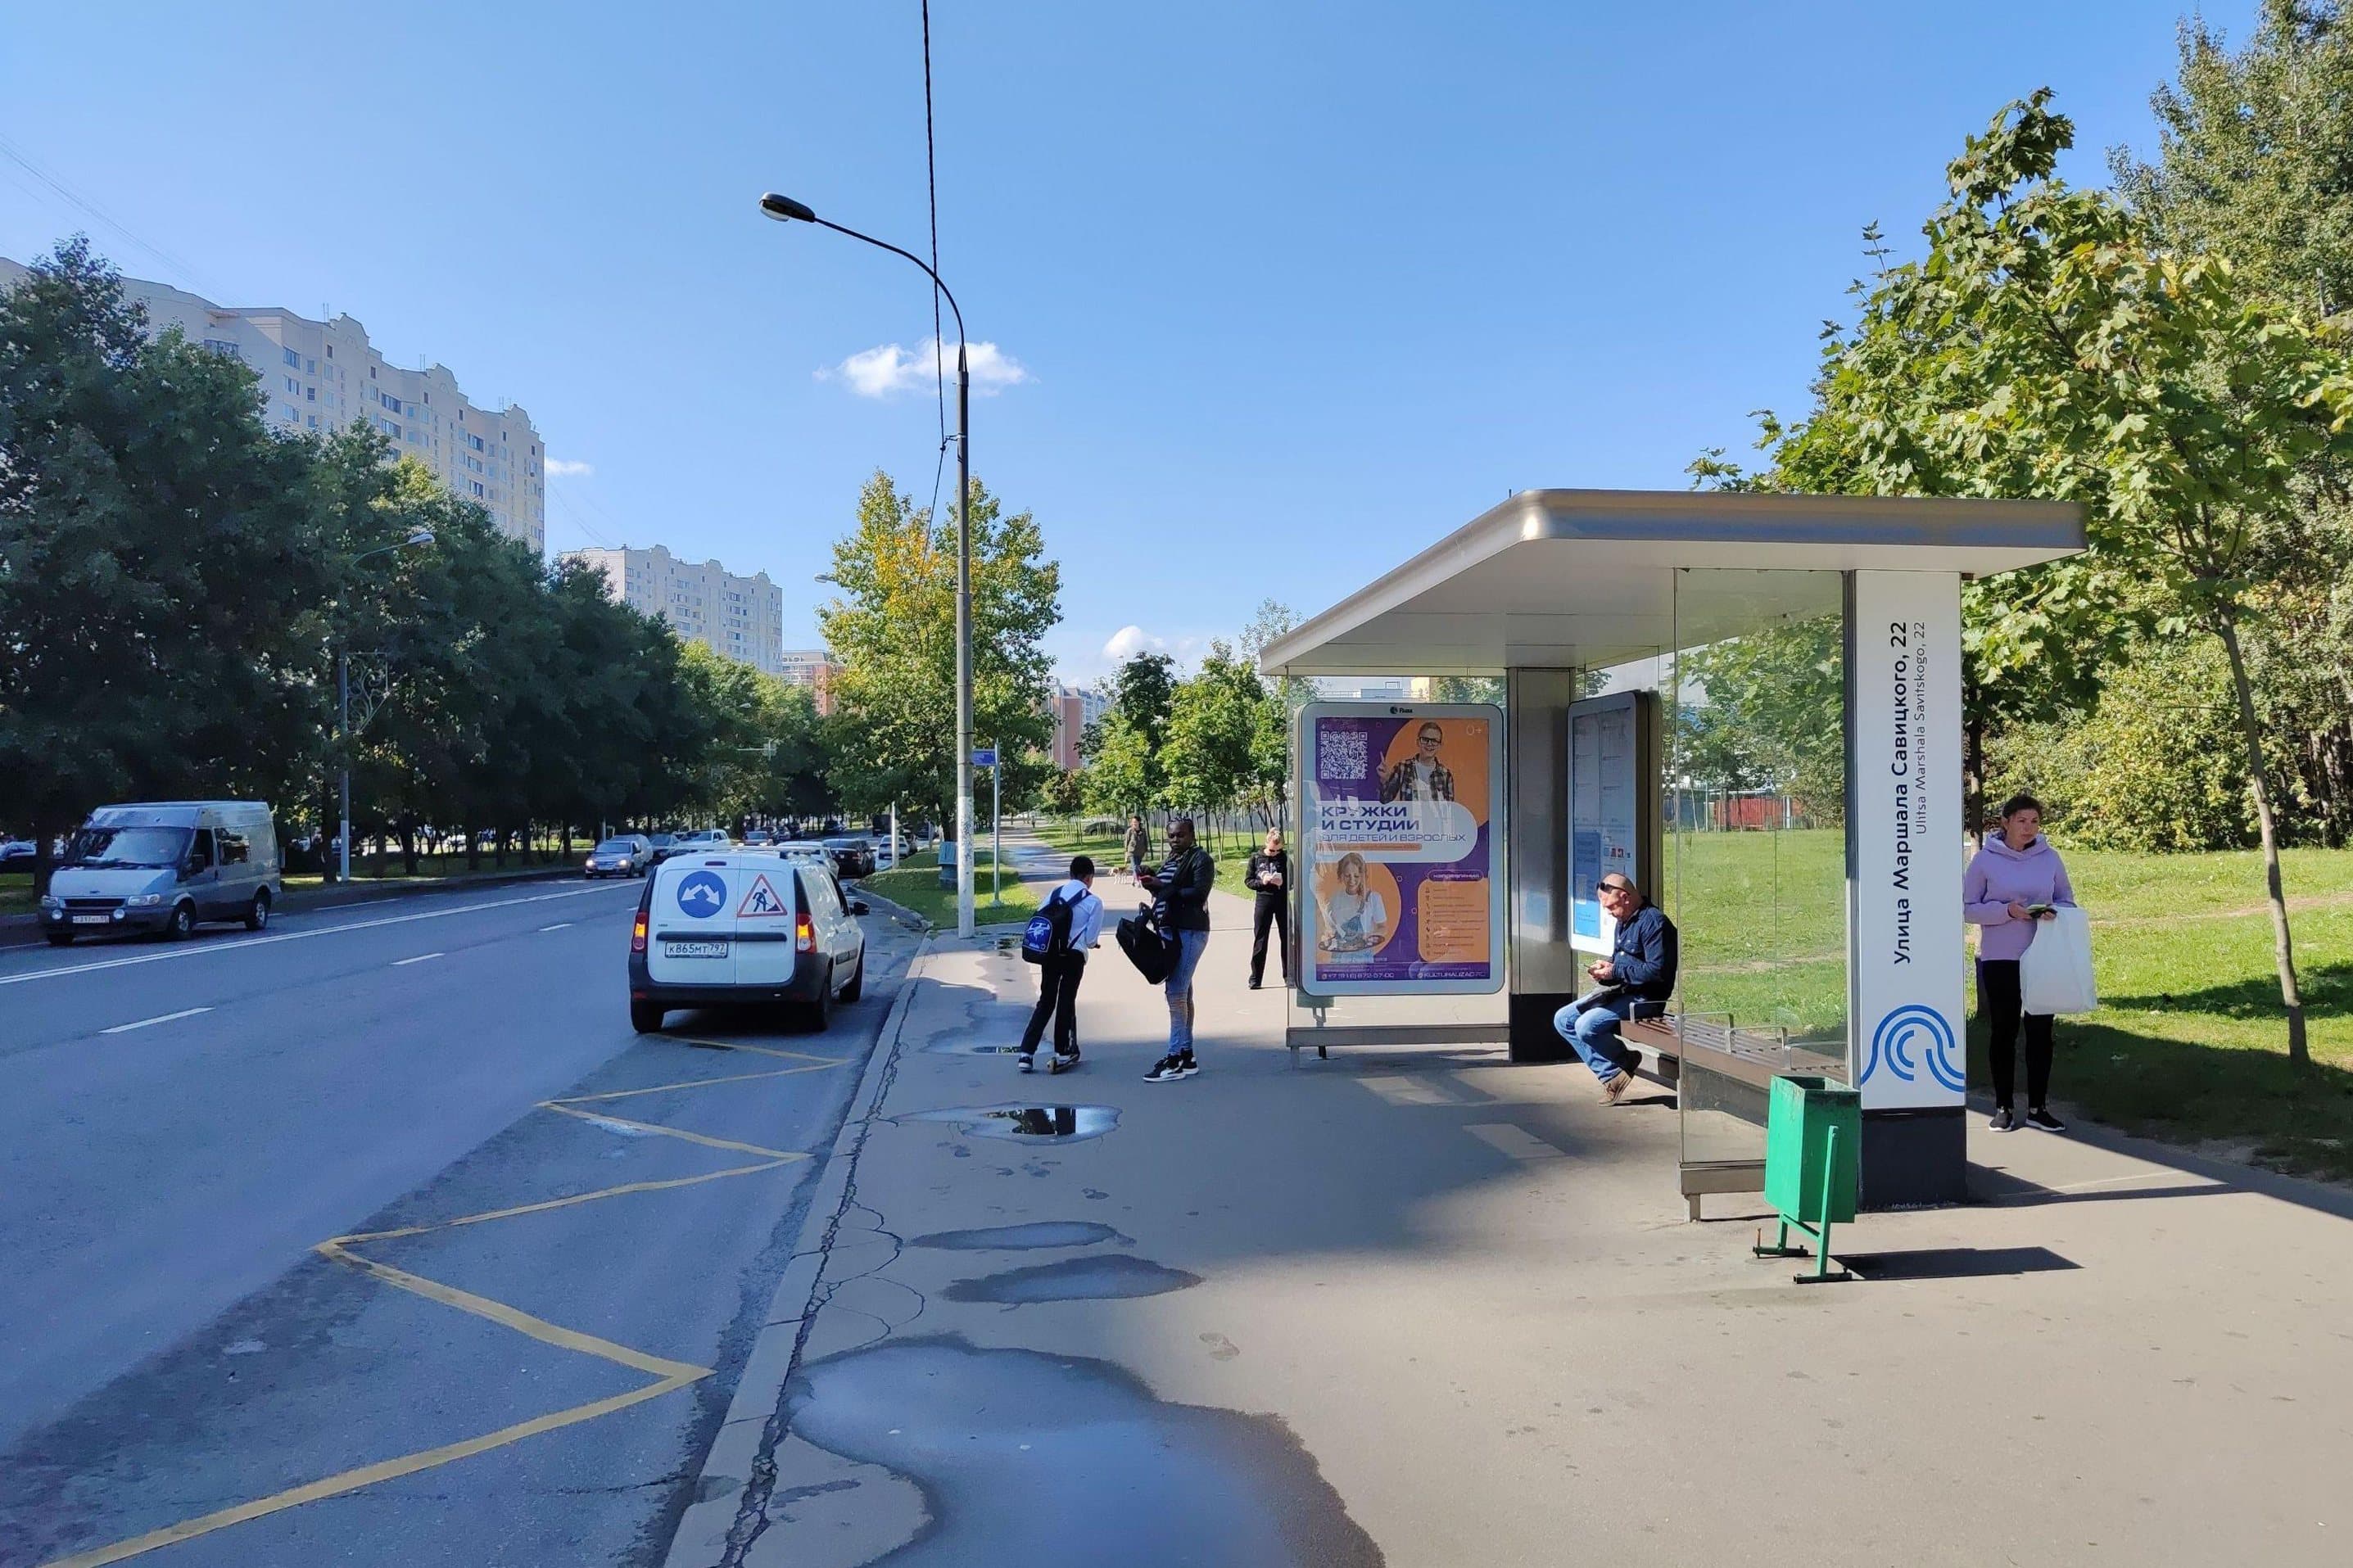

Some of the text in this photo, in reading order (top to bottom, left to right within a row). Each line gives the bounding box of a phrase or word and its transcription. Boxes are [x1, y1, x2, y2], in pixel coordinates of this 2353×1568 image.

[1913, 621, 1928, 834] Ulitsa Marshala Savitskogo, 22
[1321, 820, 1420, 832] И СТУДИИ
[1348, 832, 1387, 843] ДЕТЕЙ
[1389, 834, 1397, 842] И
[1399, 834, 1467, 842] ВЗРОСЛЫХ
[1890, 621, 1912, 965] Улица Маршала Савицкого, 22
